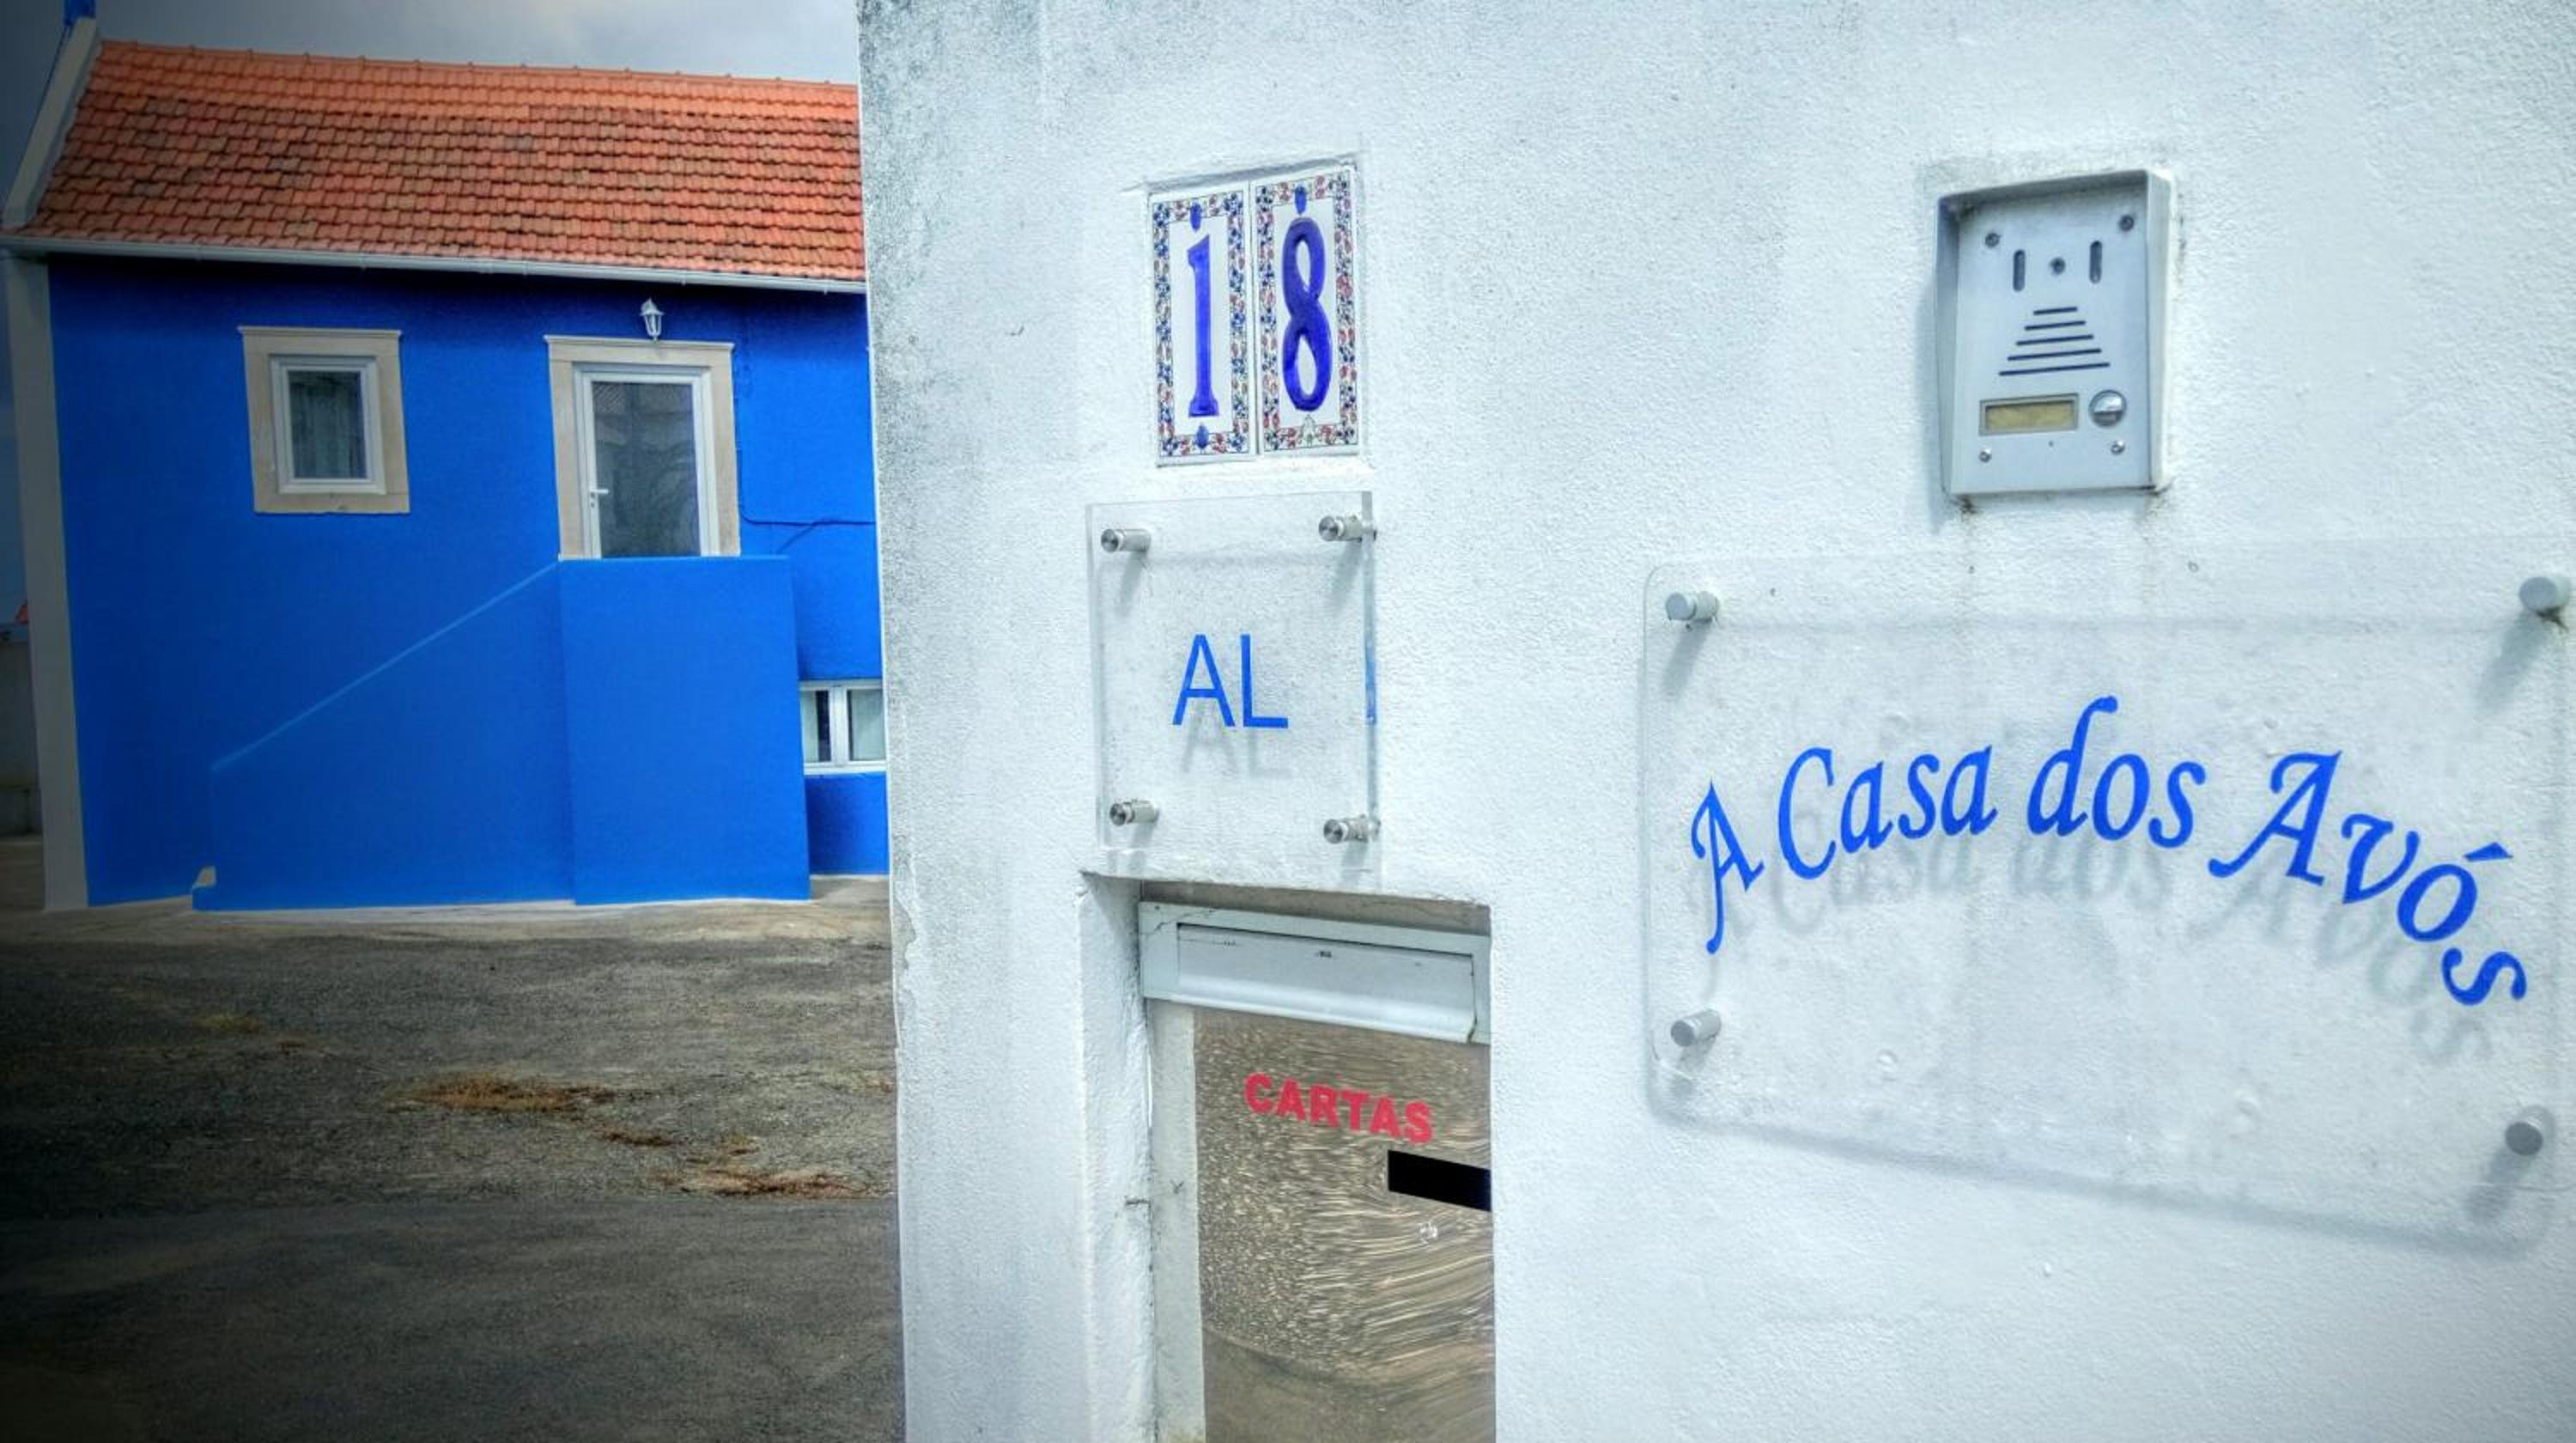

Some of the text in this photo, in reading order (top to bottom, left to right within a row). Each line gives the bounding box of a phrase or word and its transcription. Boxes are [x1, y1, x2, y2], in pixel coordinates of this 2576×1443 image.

[1187, 218, 1333, 417] 18
[1172, 632, 1291, 729] AL
[1690, 695, 2528, 1007] A Casa dos Avós
[1244, 1072, 1434, 1145] CARTAS
